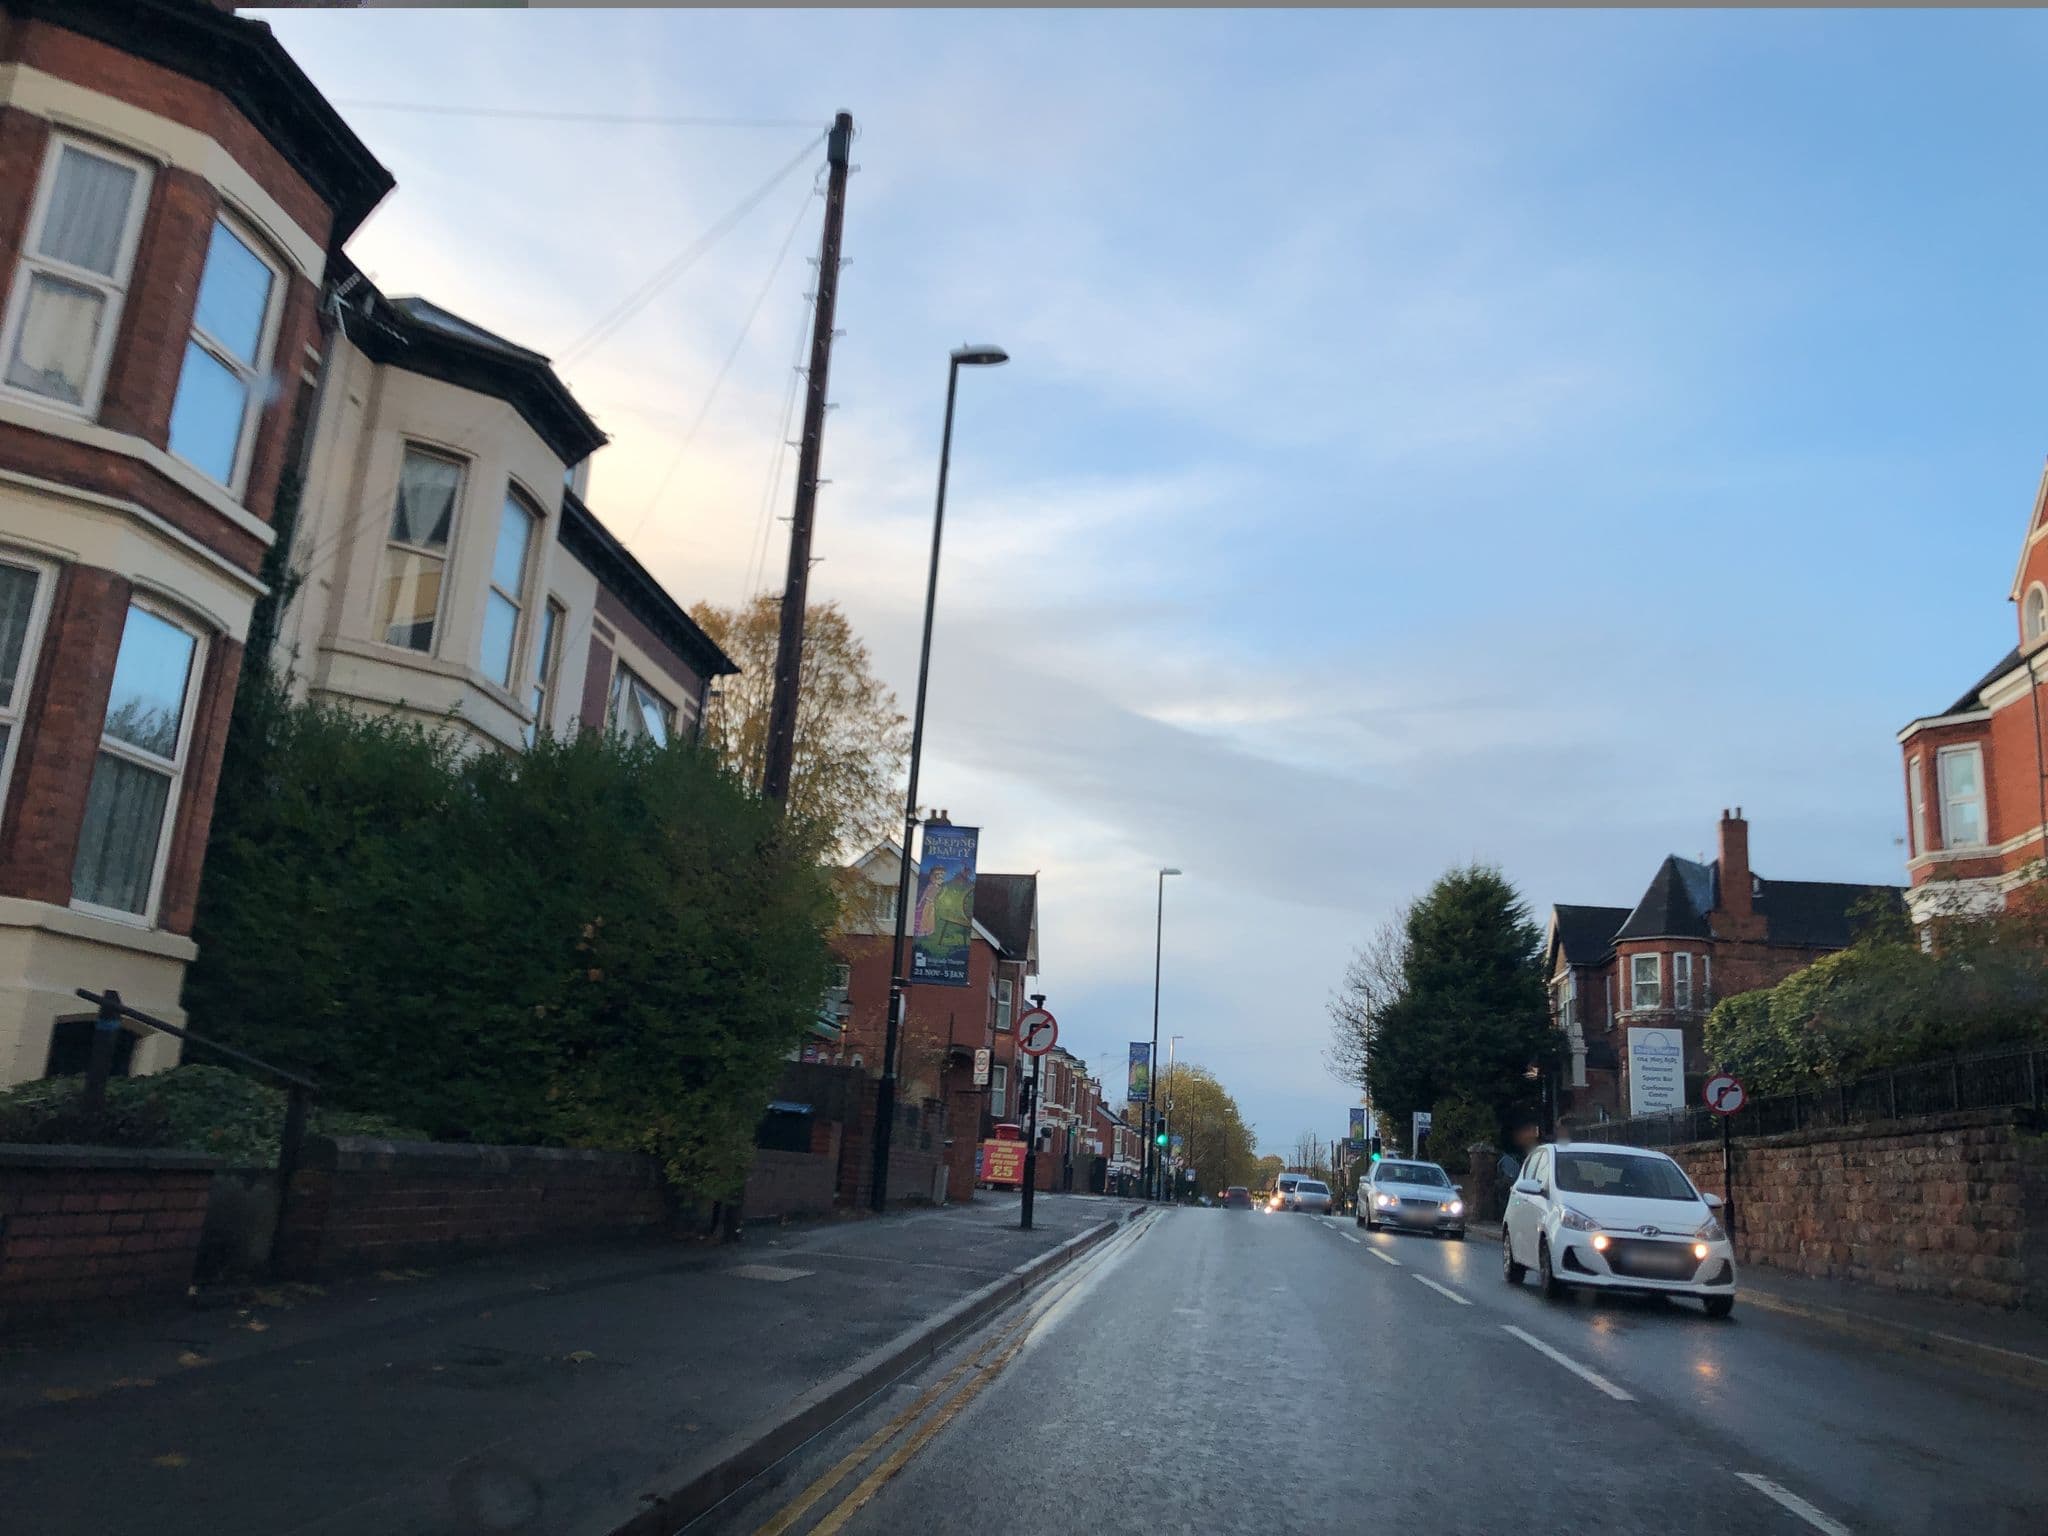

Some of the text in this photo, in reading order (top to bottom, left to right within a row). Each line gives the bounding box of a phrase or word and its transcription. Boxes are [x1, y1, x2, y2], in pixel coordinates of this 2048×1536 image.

[925, 836, 976, 849] SLEEPING
[927, 846, 970, 858] BEAUTY
[925, 969, 940, 977] NOV
[950, 971, 965, 979] JAN
